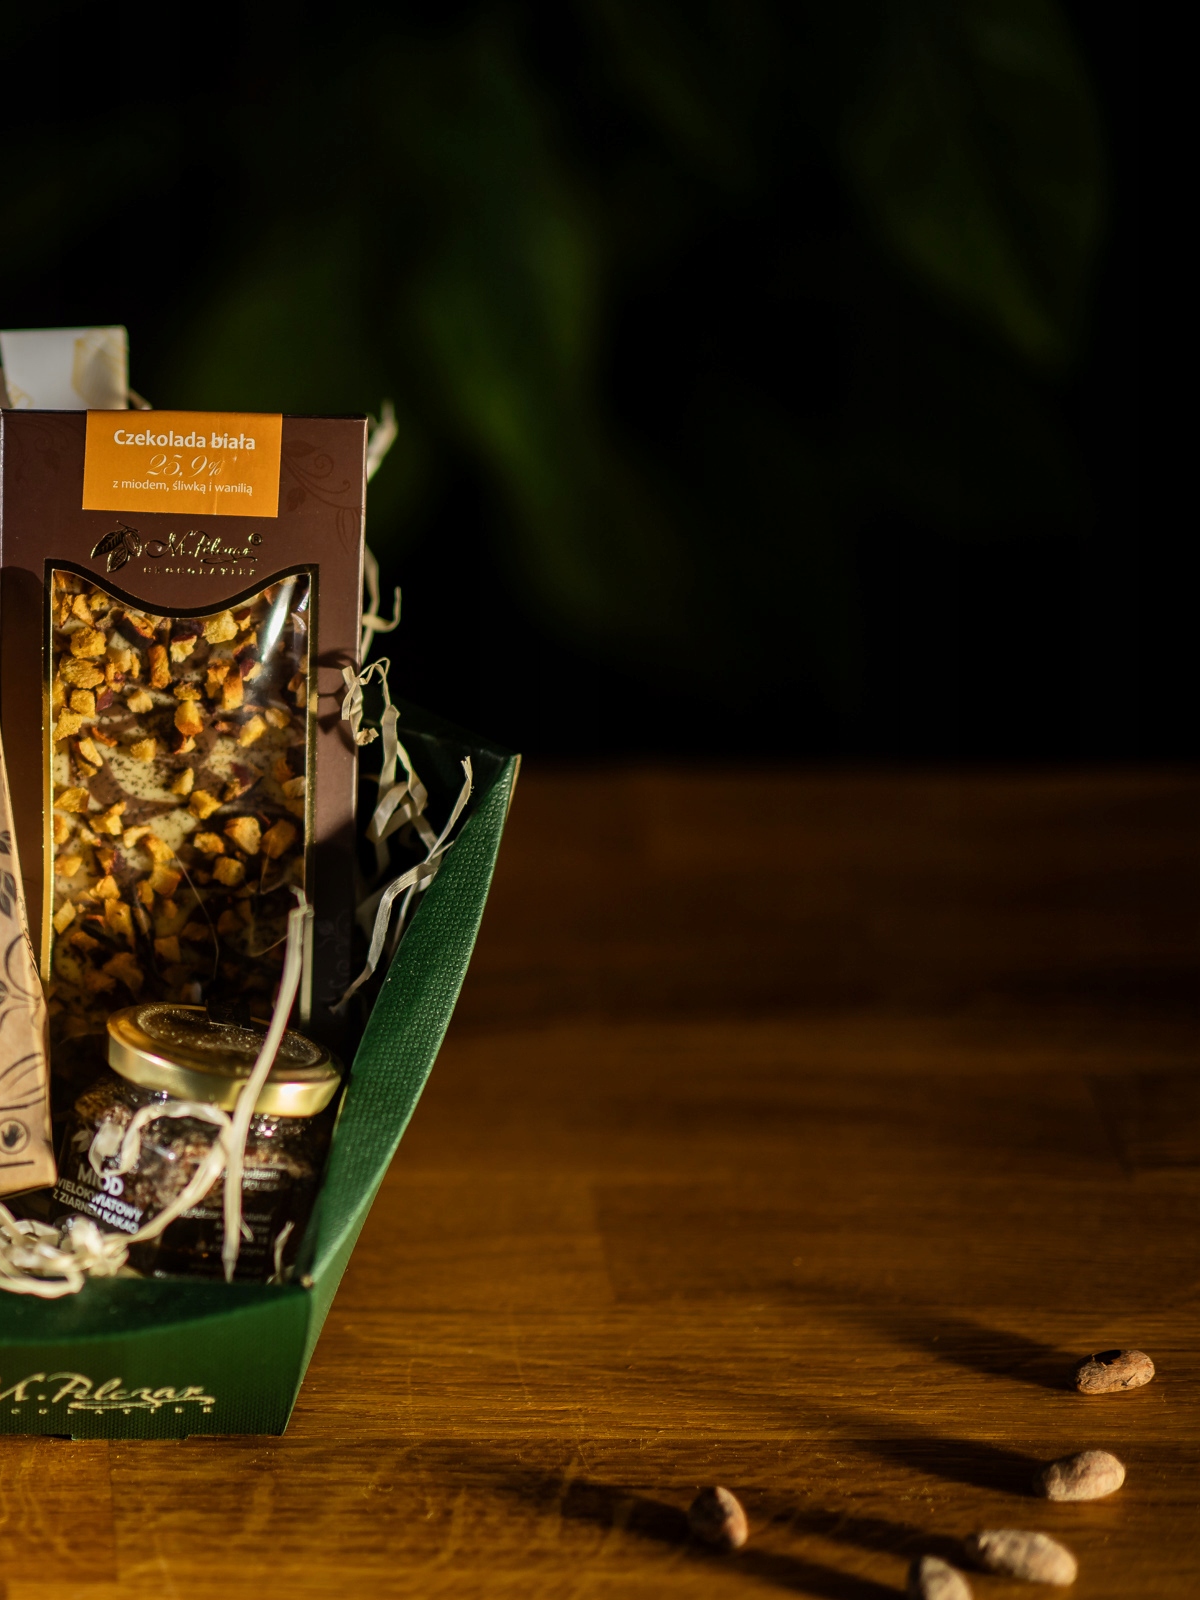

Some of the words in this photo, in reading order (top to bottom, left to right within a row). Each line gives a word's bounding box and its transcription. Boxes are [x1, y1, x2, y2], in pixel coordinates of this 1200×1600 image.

[113, 429, 206, 448] Czekolada
[211, 432, 256, 450] biała
[146, 453, 222, 478] 25,9%
[112, 480, 119, 488] z
[121, 479, 170, 492] miodem,
[172, 480, 206, 494] śliwką
[208, 481, 212, 492] i
[214, 482, 253, 496] wanilią
